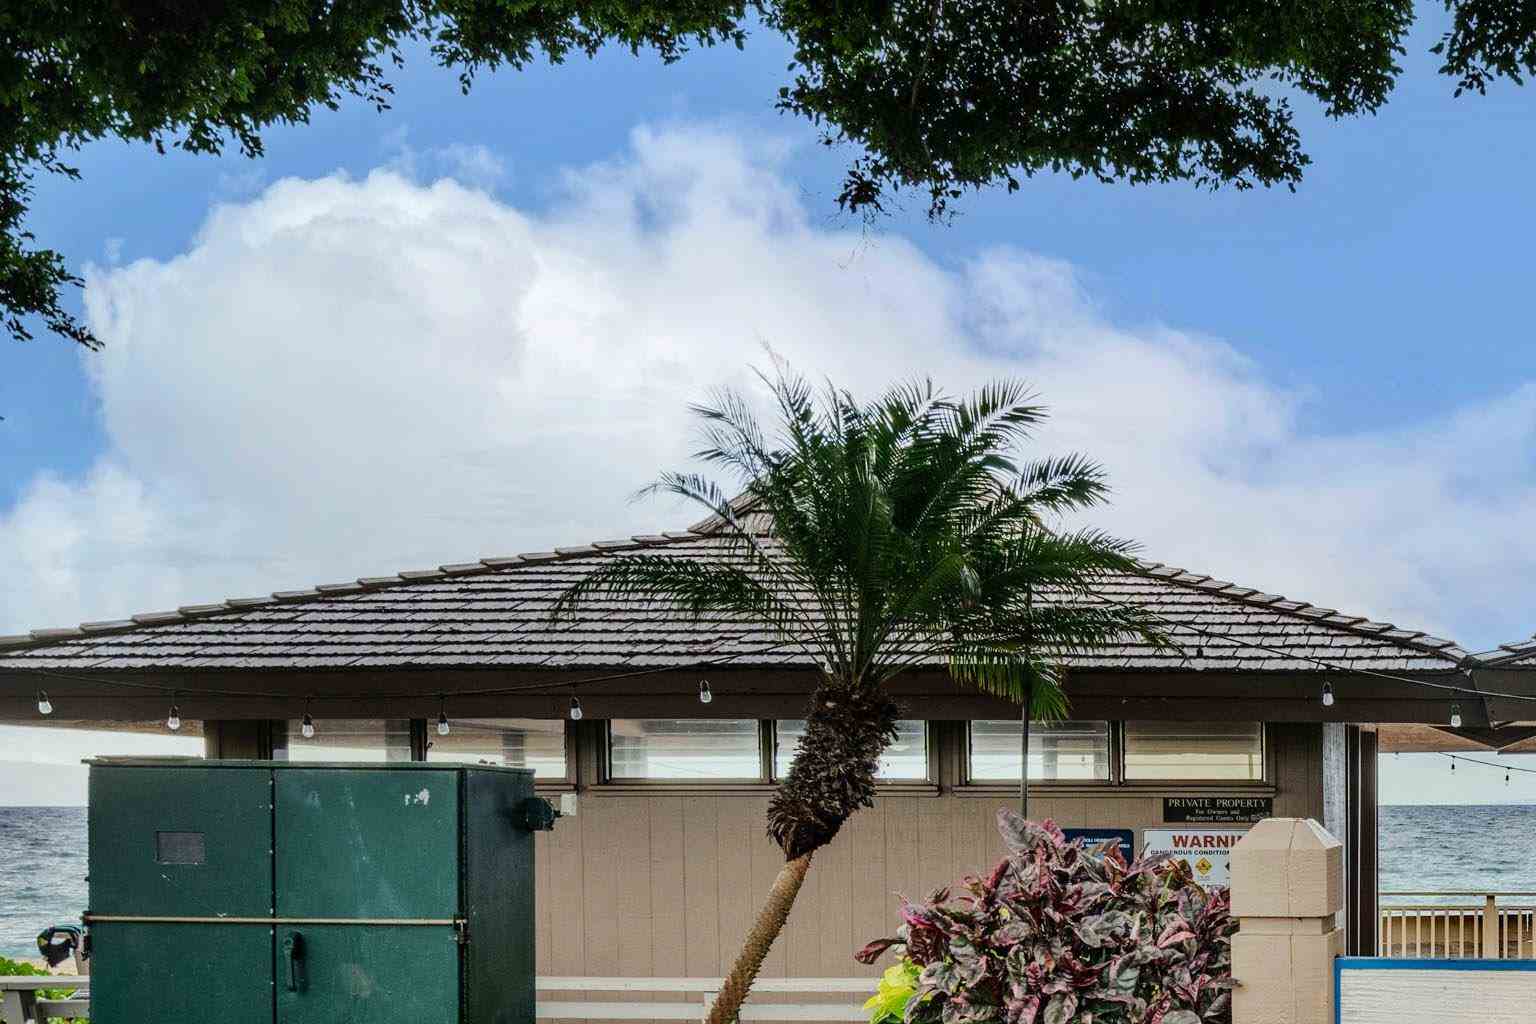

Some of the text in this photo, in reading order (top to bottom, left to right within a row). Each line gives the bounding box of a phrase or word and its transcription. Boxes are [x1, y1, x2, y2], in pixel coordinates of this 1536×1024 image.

[1168, 799, 1266, 808] PRIVATE PROPERTY
[1172, 835, 1243, 848] WARNI
